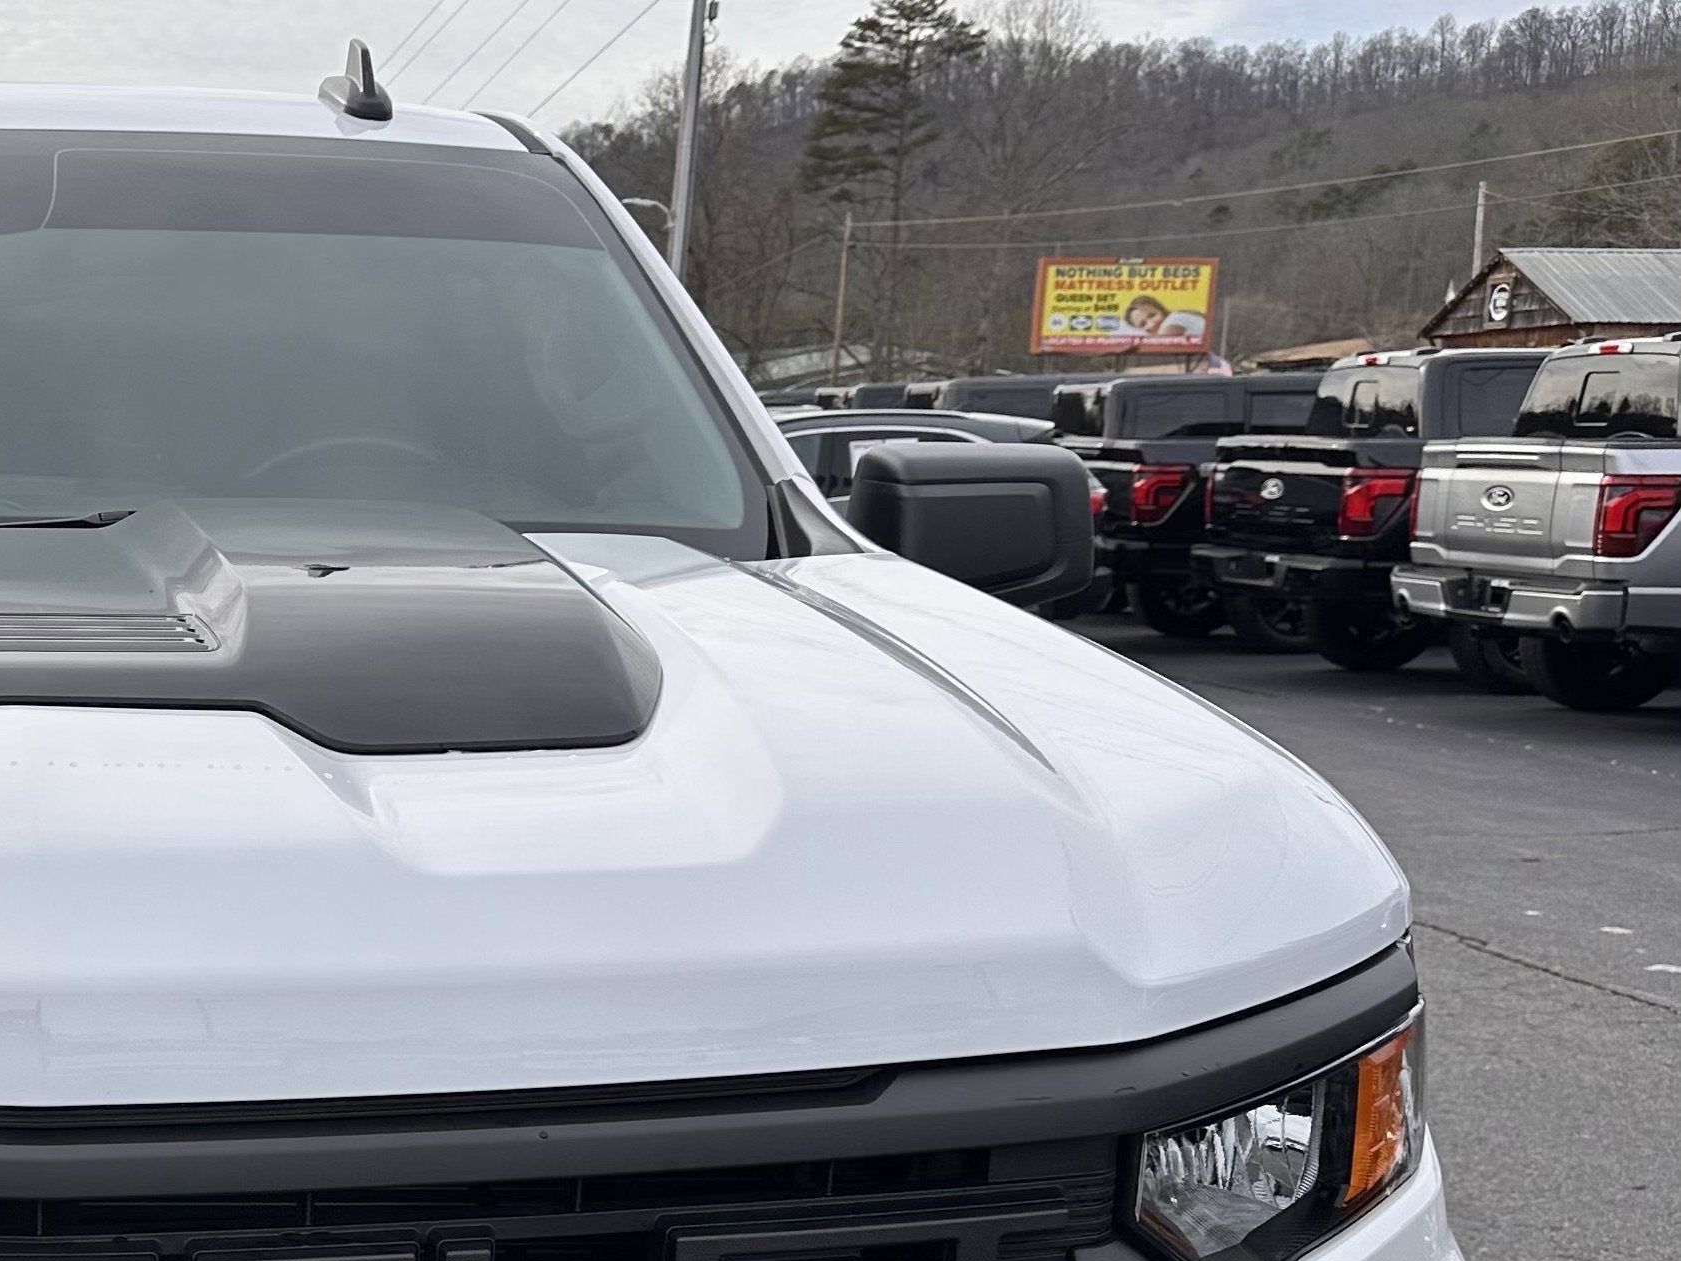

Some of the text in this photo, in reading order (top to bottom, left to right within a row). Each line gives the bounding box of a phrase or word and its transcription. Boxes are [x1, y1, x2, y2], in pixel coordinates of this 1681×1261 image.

[1055, 267, 1200, 278] NOTHING BUT BEDS
[1054, 280, 1199, 291] MATTRESS OUTLET
[1055, 293, 1117, 302] QUEEN SET
